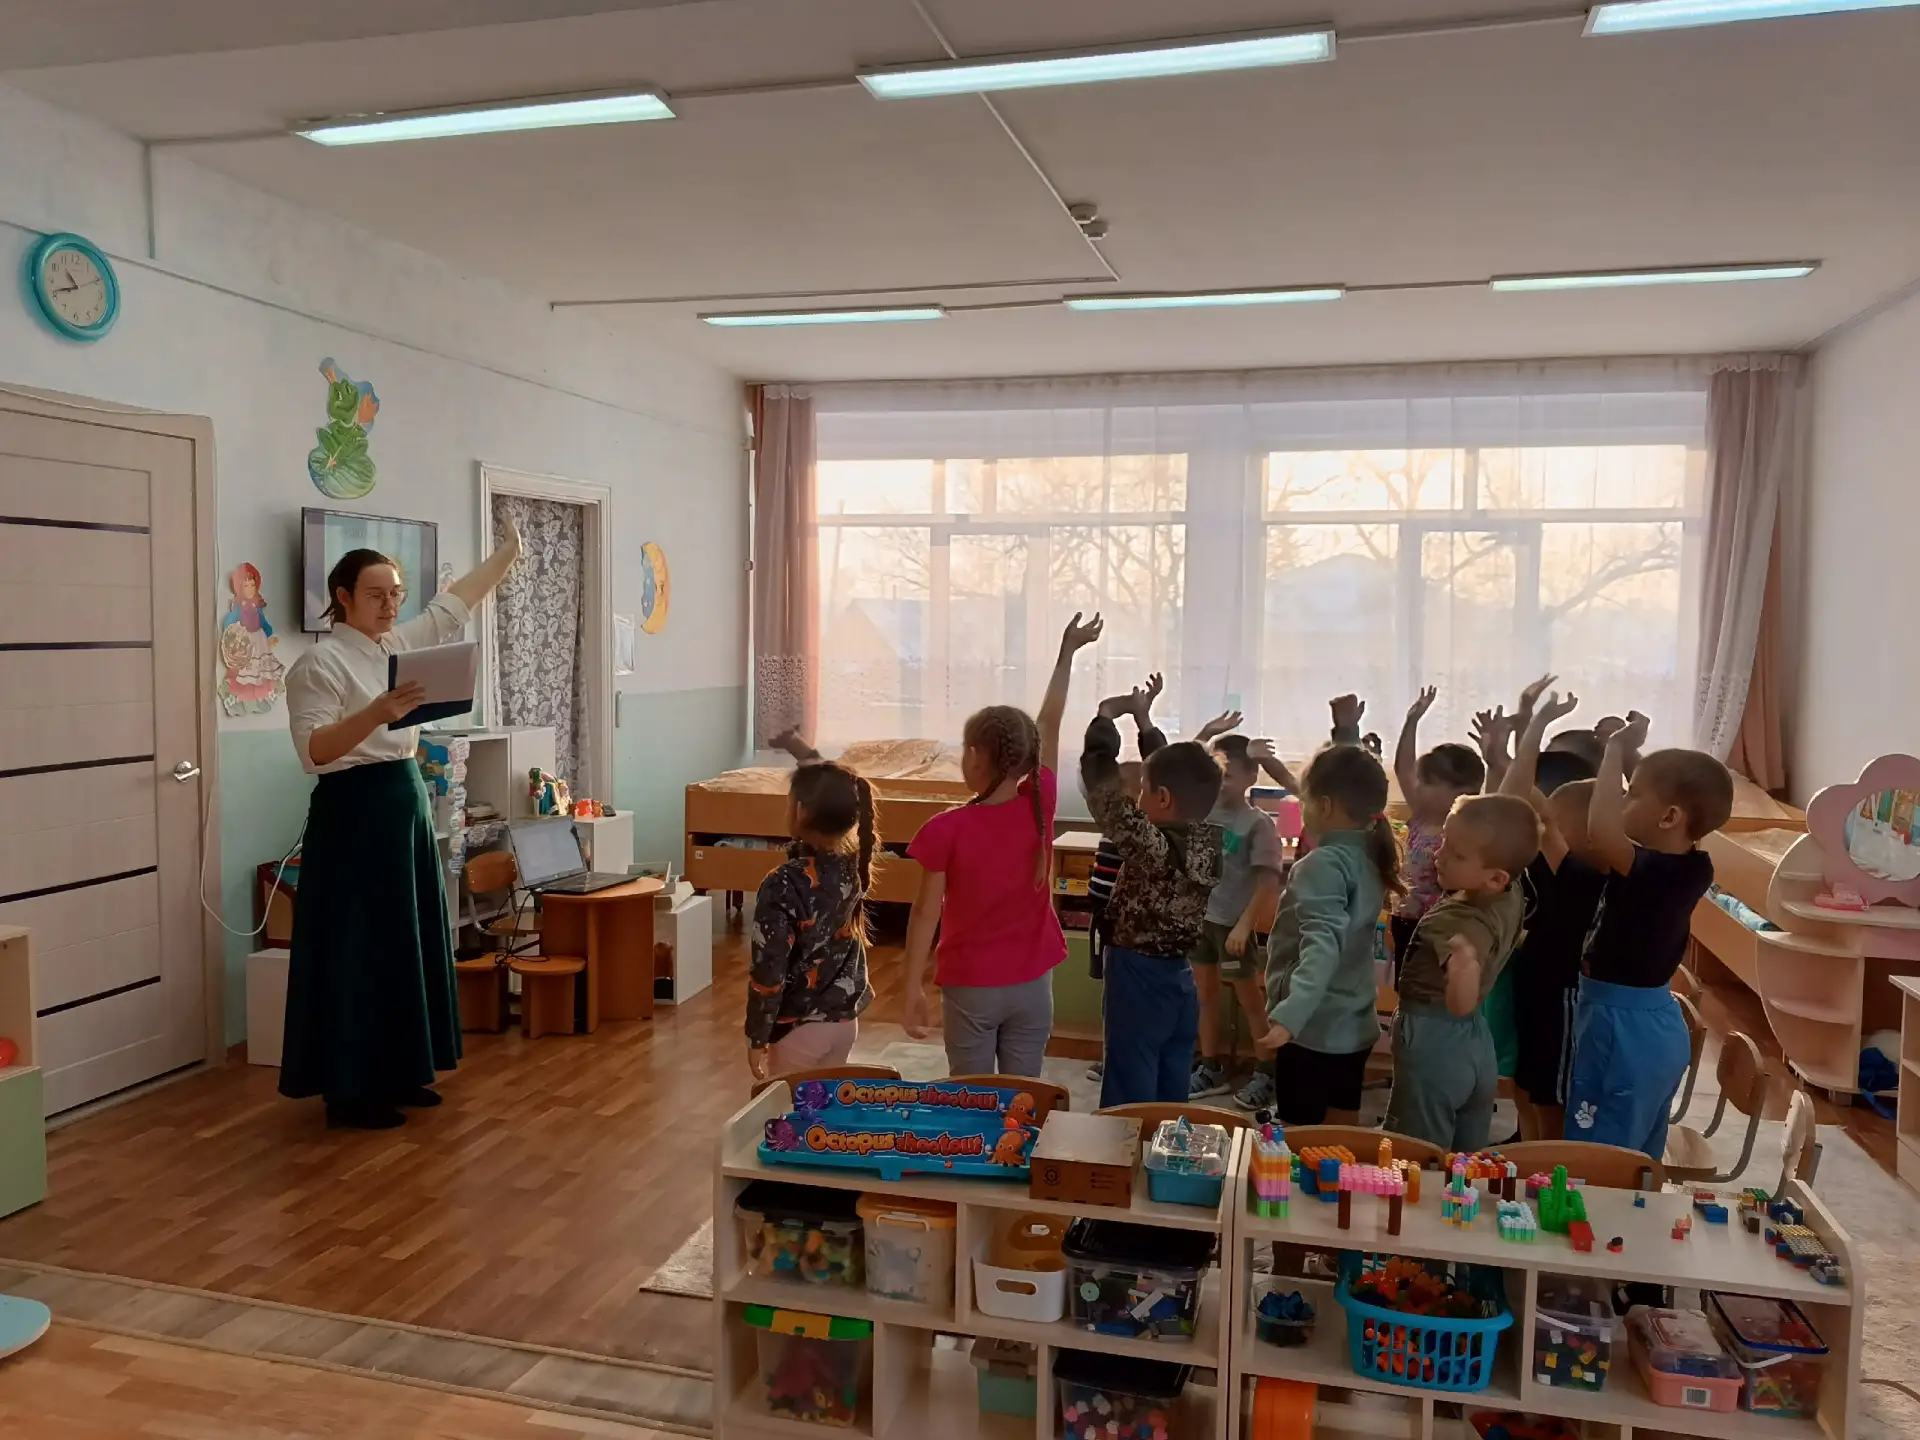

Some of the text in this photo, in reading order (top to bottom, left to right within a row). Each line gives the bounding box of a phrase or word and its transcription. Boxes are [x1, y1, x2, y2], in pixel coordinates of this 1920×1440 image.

[61, 253, 67, 266] 11
[71, 253, 80, 265] 12
[51, 262, 60, 272] 10
[52, 291, 58, 301] 8
[61, 303, 67, 313] 7
[73, 312, 79, 322] 6
[85, 309, 91, 320] 5
[836, 1080, 999, 1111] Octopus shootout
[806, 1124, 984, 1157] Octopus shootout
